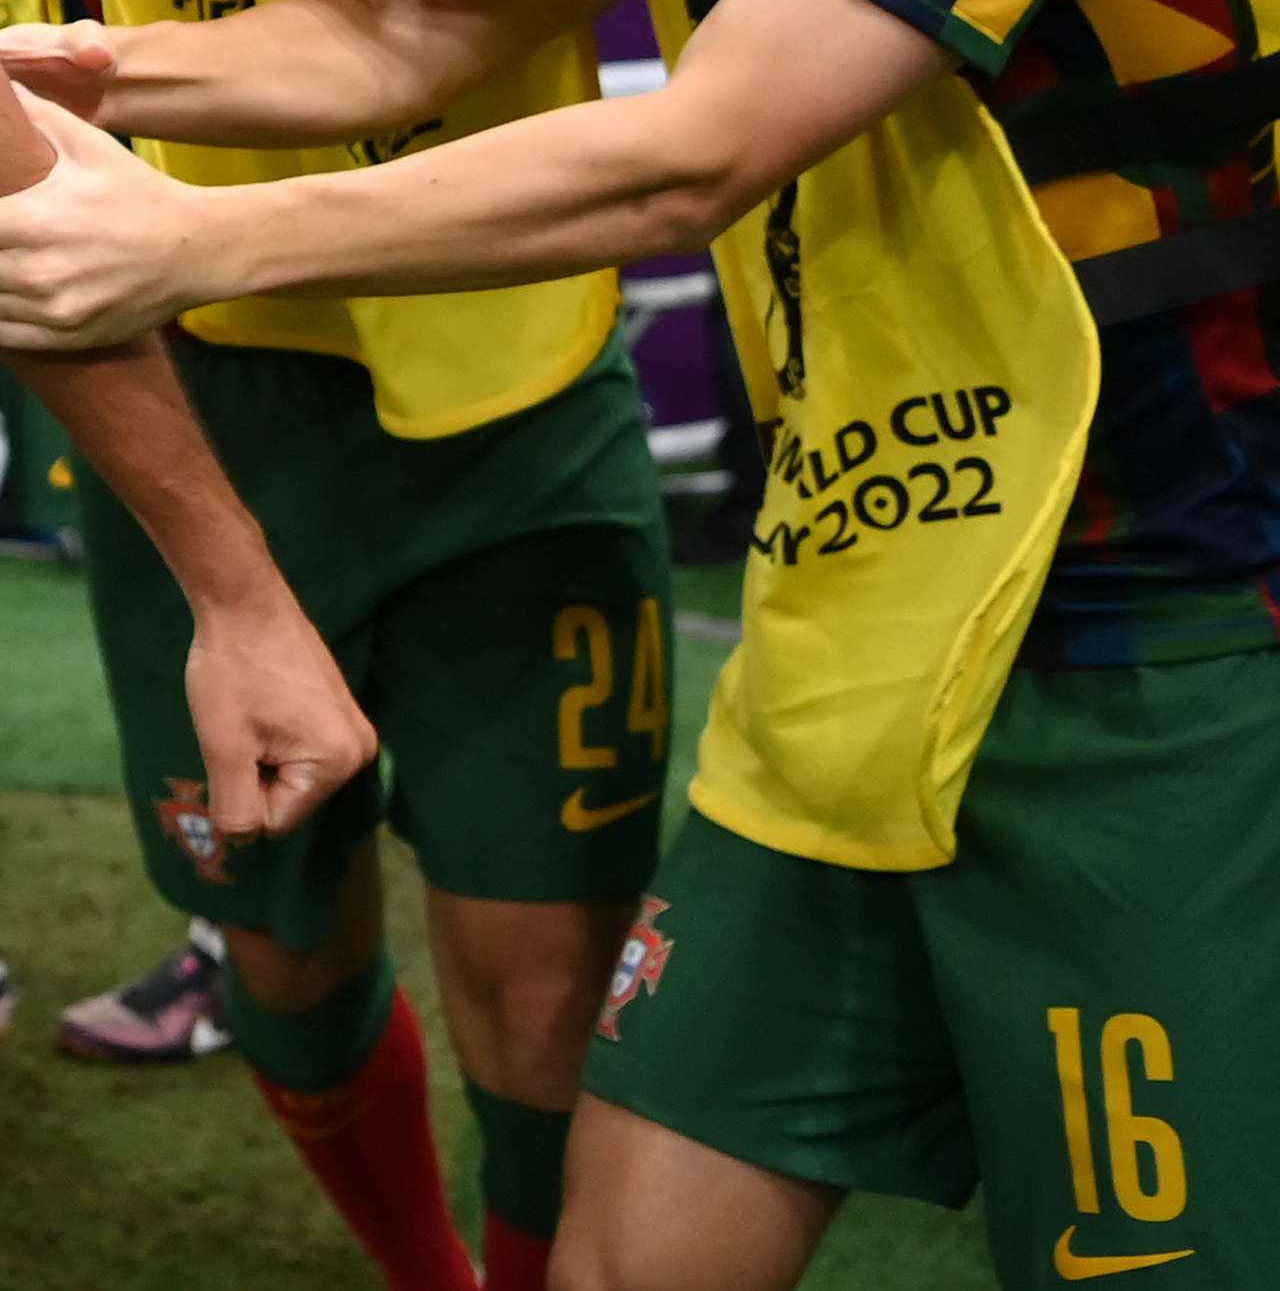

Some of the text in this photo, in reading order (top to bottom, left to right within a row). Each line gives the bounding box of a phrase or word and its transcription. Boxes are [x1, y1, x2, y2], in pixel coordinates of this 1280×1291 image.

[890, 385, 1012, 447] CUP
[553, 596, 671, 769] 24
[1046, 1006, 1188, 1223] 16
